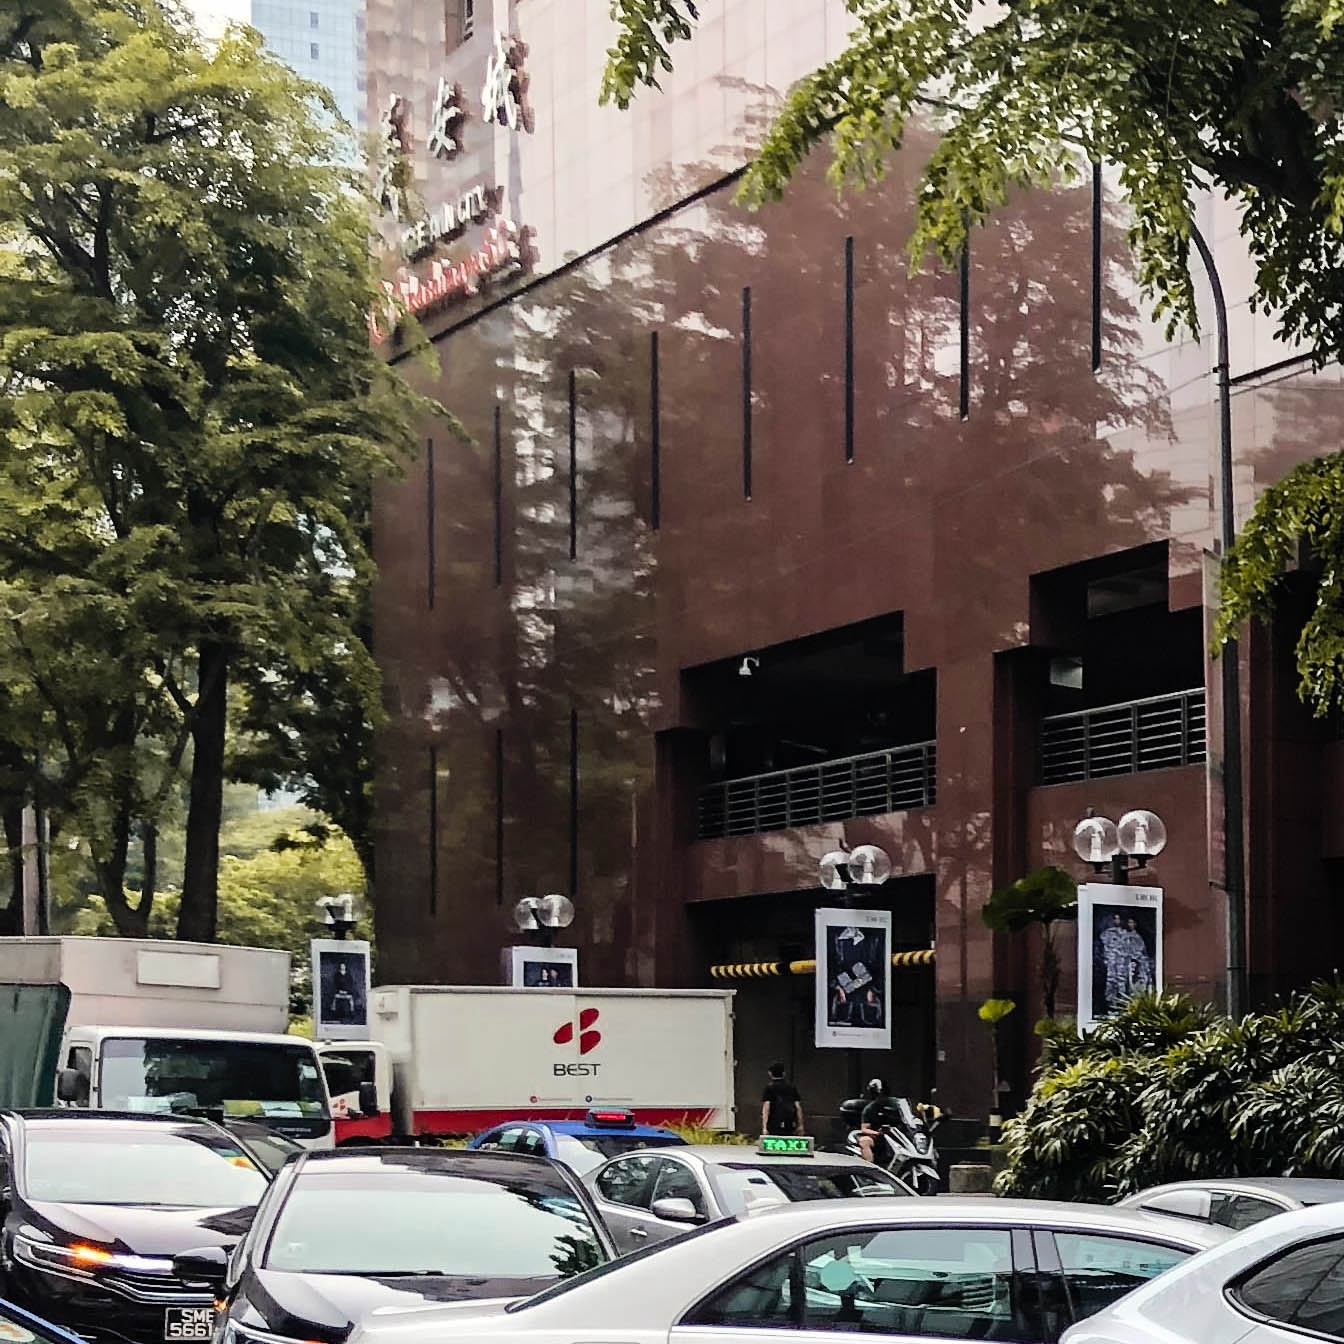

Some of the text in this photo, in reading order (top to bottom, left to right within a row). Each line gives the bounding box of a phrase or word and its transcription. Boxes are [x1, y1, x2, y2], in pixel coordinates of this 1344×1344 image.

[553, 1063, 601, 1076] BEST
[763, 1139, 809, 1151] TAXI
[169, 1322, 217, 1338] 5661
